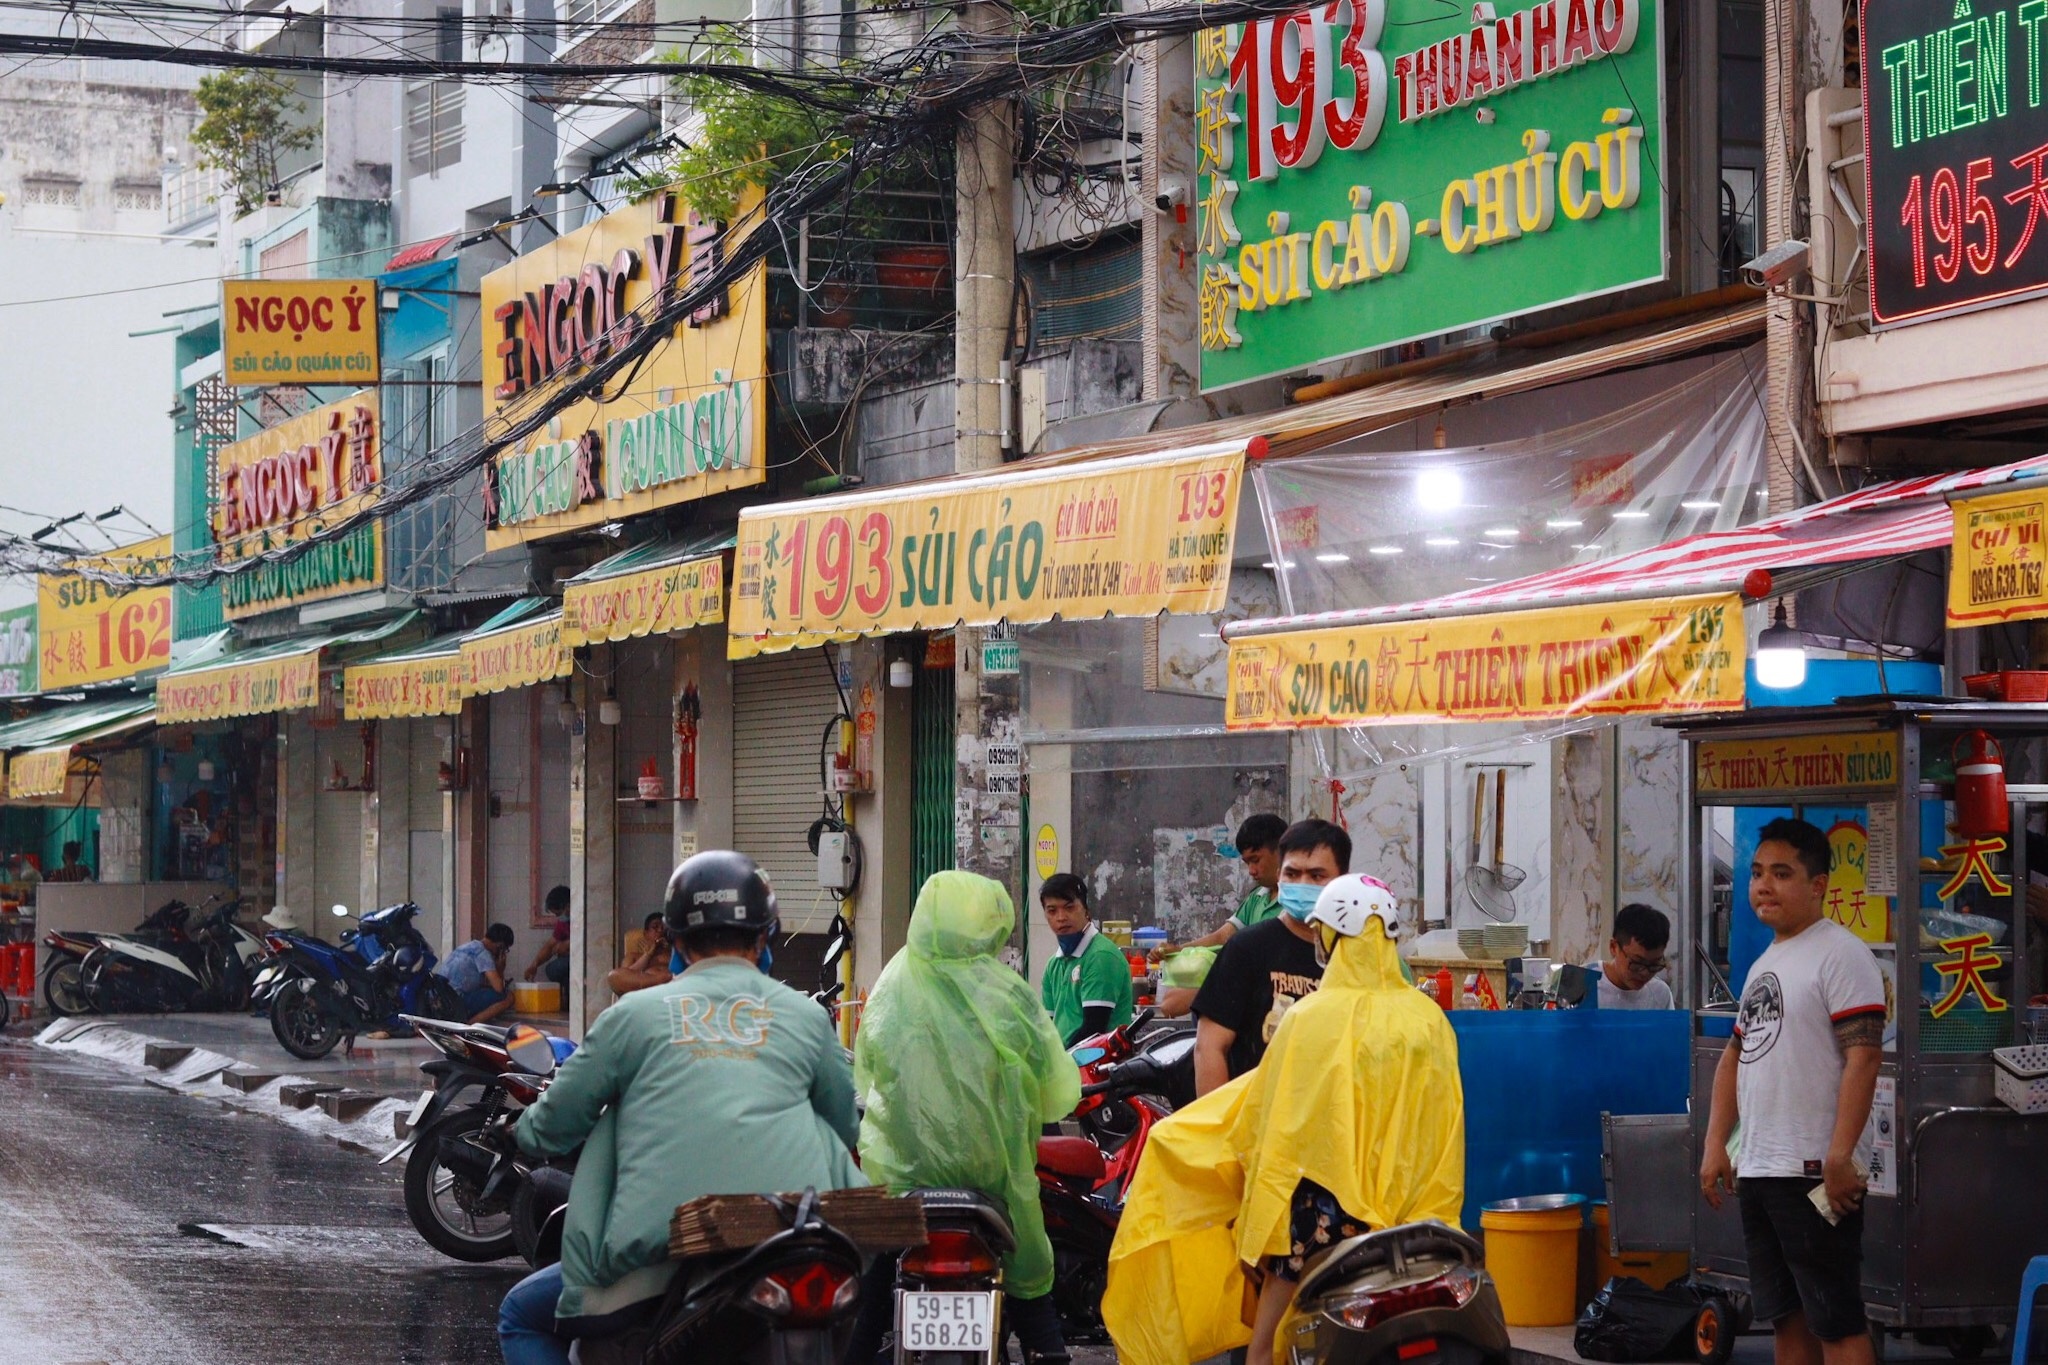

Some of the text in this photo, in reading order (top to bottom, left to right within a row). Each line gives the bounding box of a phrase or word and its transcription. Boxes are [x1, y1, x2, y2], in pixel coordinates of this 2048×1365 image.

[1230, 0, 1384, 181] 193
[1394, 2, 1523, 124] THUẬN
[1882, 0, 2007, 148] THIÊN
[1239, 212, 1310, 312] SỦI
[1312, 186, 1407, 290] CẢO
[1441, 130, 1556, 254] CHỦ
[1902, 157, 1998, 287] 195
[234, 285, 367, 342] NGỌC Ý
[232, 351, 371, 374] SỦI CẢO (QUÁN CŨ)
[319, 412, 346, 503] Ý
[1178, 472, 1227, 523] 193
[782, 512, 892, 618] 193
[900, 505, 956, 608] SỦI
[968, 497, 1043, 611] CẢO
[1054, 565, 1080, 599] 10H30
[1101, 561, 1121, 596] 24H
[1190, 564, 1195, 583] 4
[1972, 561, 2042, 602] 0938.638.763
[96, 596, 171, 670] 162
[1687, 605, 1724, 643] 195
[1288, 642, 1324, 716] SỦI
[1329, 639, 1369, 715] CẢO
[1404, 632, 1430, 712] 天
[1433, 626, 1531, 711] THIÊN
[1537, 616, 1645, 706] THIÊN
[1701, 738, 1892, 789] 天 THIÊN 天 THIÊN SỦI CẢO
[1827, 888, 1868, 928] 天天
[664, 992, 770, 1048] RG
[923, 1191, 970, 1199] HONDA
[911, 1322, 983, 1346] 568.26
[916, 1297, 975, 1320] 59-E1
